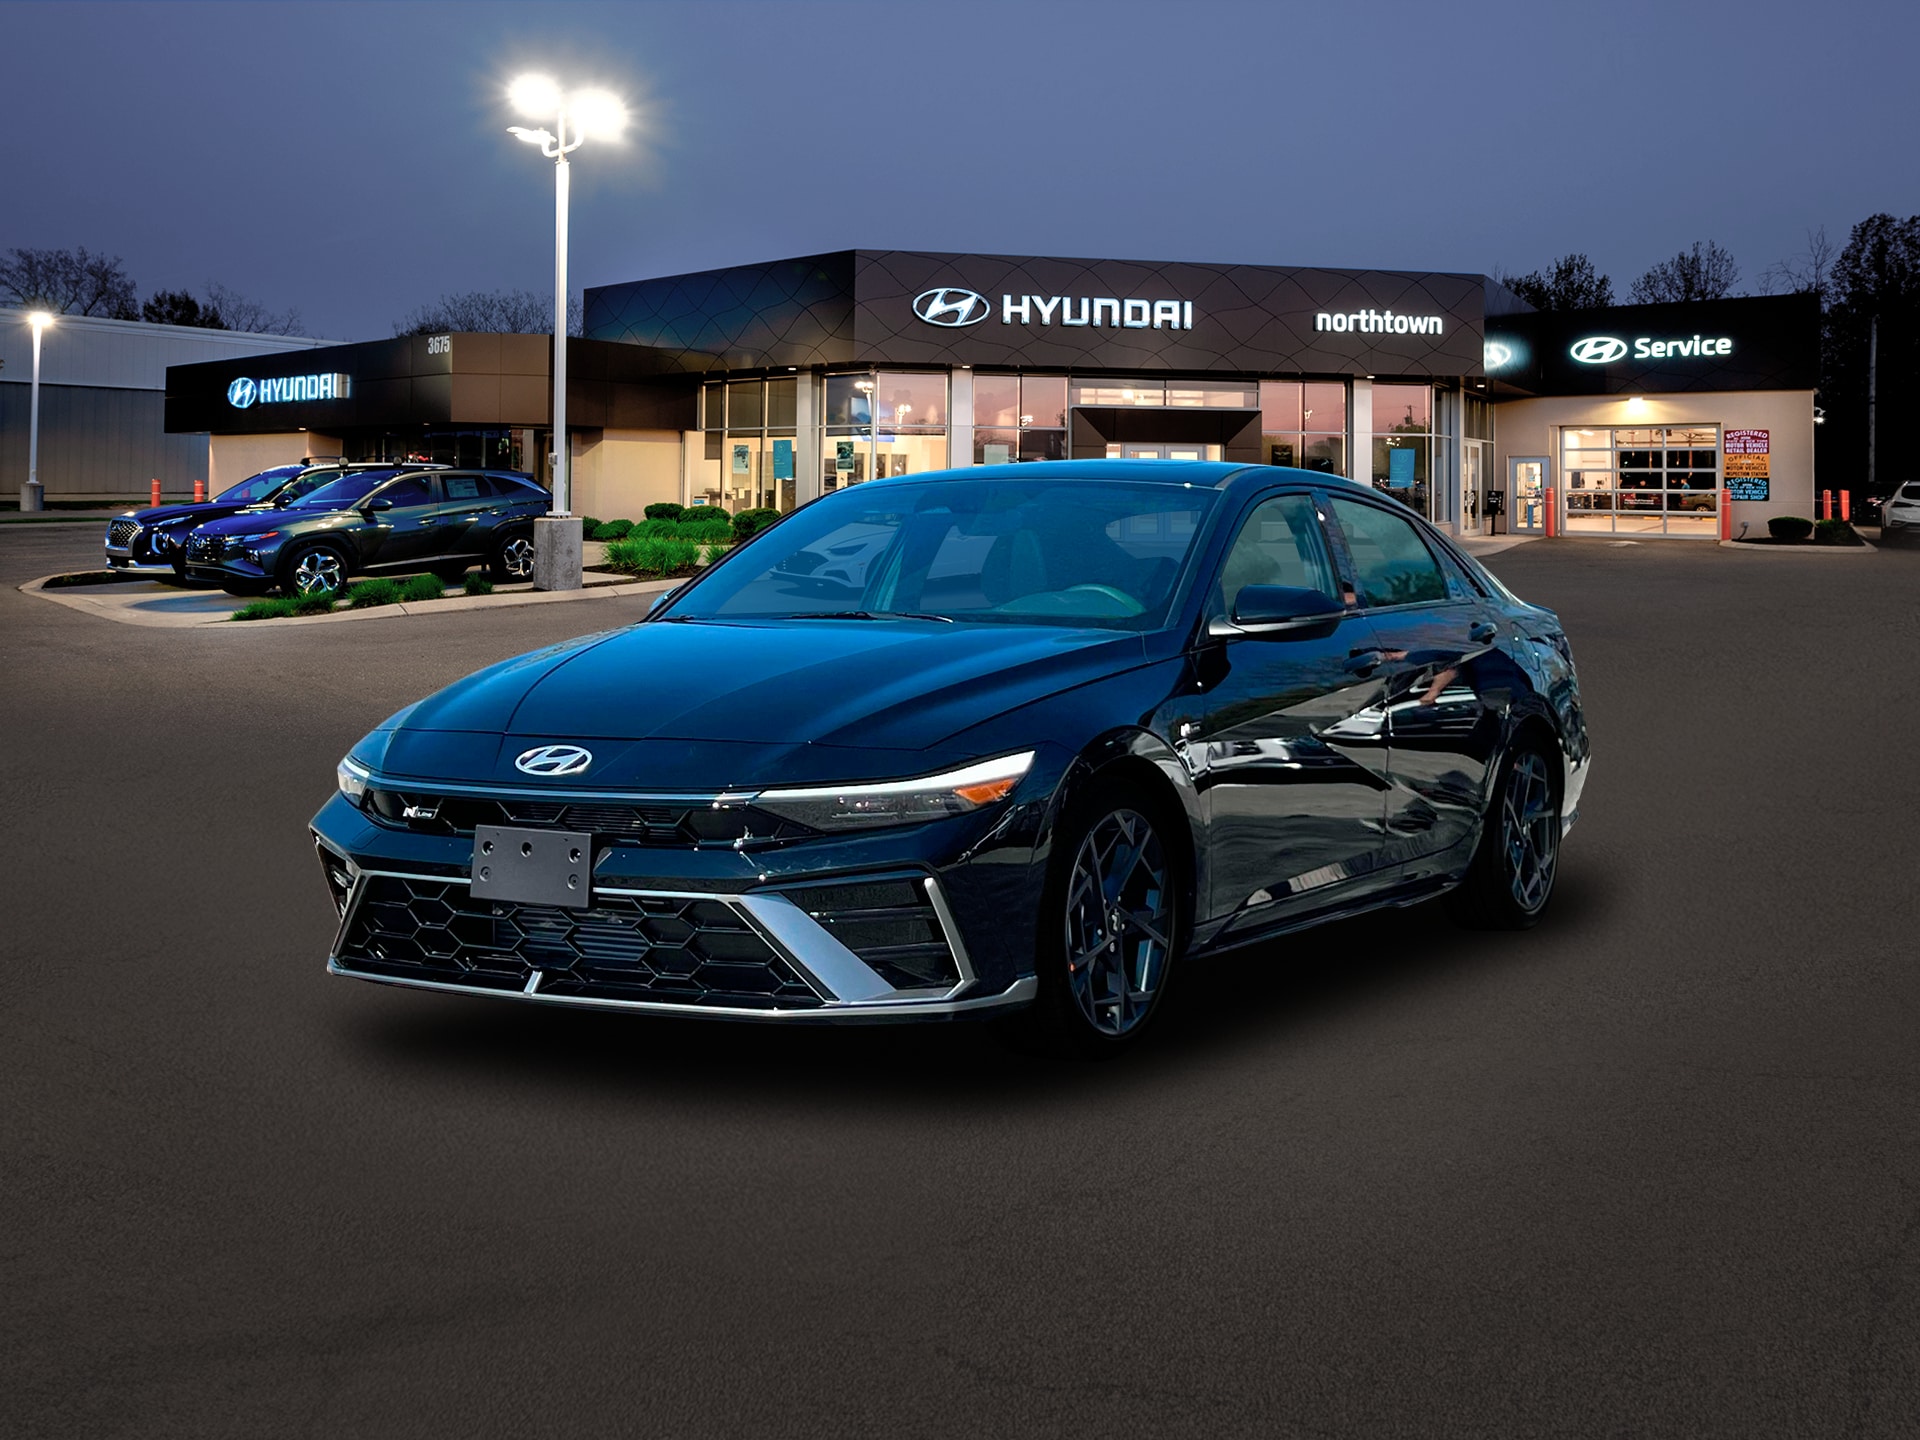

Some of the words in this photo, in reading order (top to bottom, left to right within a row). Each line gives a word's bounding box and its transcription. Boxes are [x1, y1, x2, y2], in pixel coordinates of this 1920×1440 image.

[1002, 294, 1192, 330] HYUNDAI
[1316, 309, 1443, 335] northtown
[428, 335, 450, 355] 3675
[1634, 335, 1732, 359] Service
[259, 372, 339, 404] HYUNDAI
[1726, 430, 1768, 439] REGISTERED
[1726, 477, 1767, 486] REGISTERED
